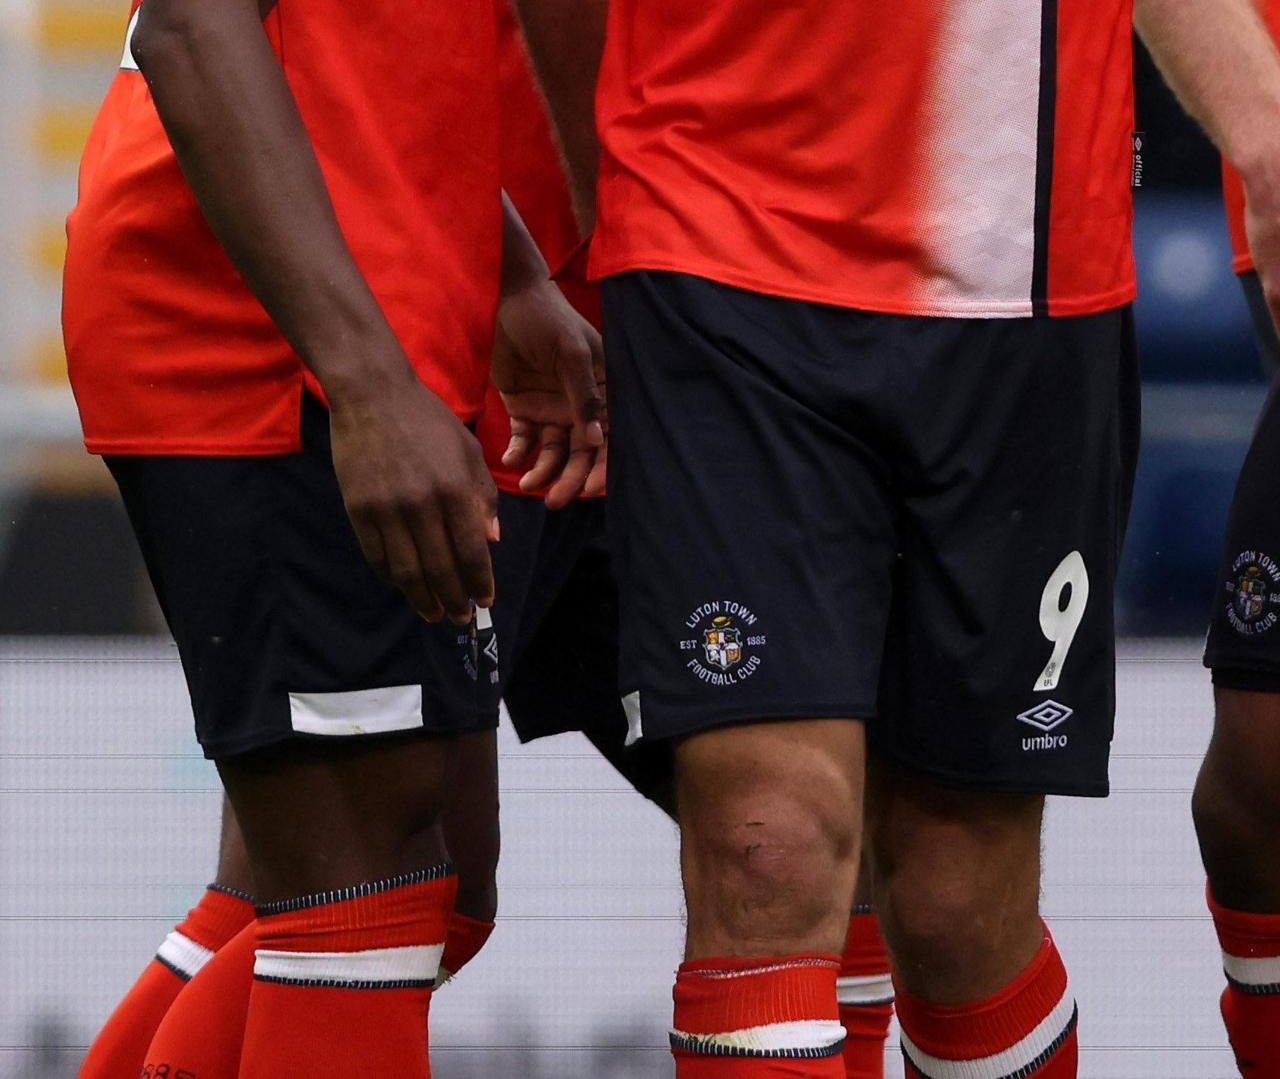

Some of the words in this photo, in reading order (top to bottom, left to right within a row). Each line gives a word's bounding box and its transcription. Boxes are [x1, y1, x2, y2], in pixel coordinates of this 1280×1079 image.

[686, 600, 720, 629] LUTON
[723, 600, 758, 626] TOWN
[1032, 550, 1090, 692] 9
[1255, 611, 1277, 633] CLUB
[679, 639, 698, 650] EST
[746, 635, 766, 646] 1885
[687, 658, 738, 686] FOOTBALL
[737, 655, 761, 680] CLUB
[1021, 733, 1068, 751] umbro
